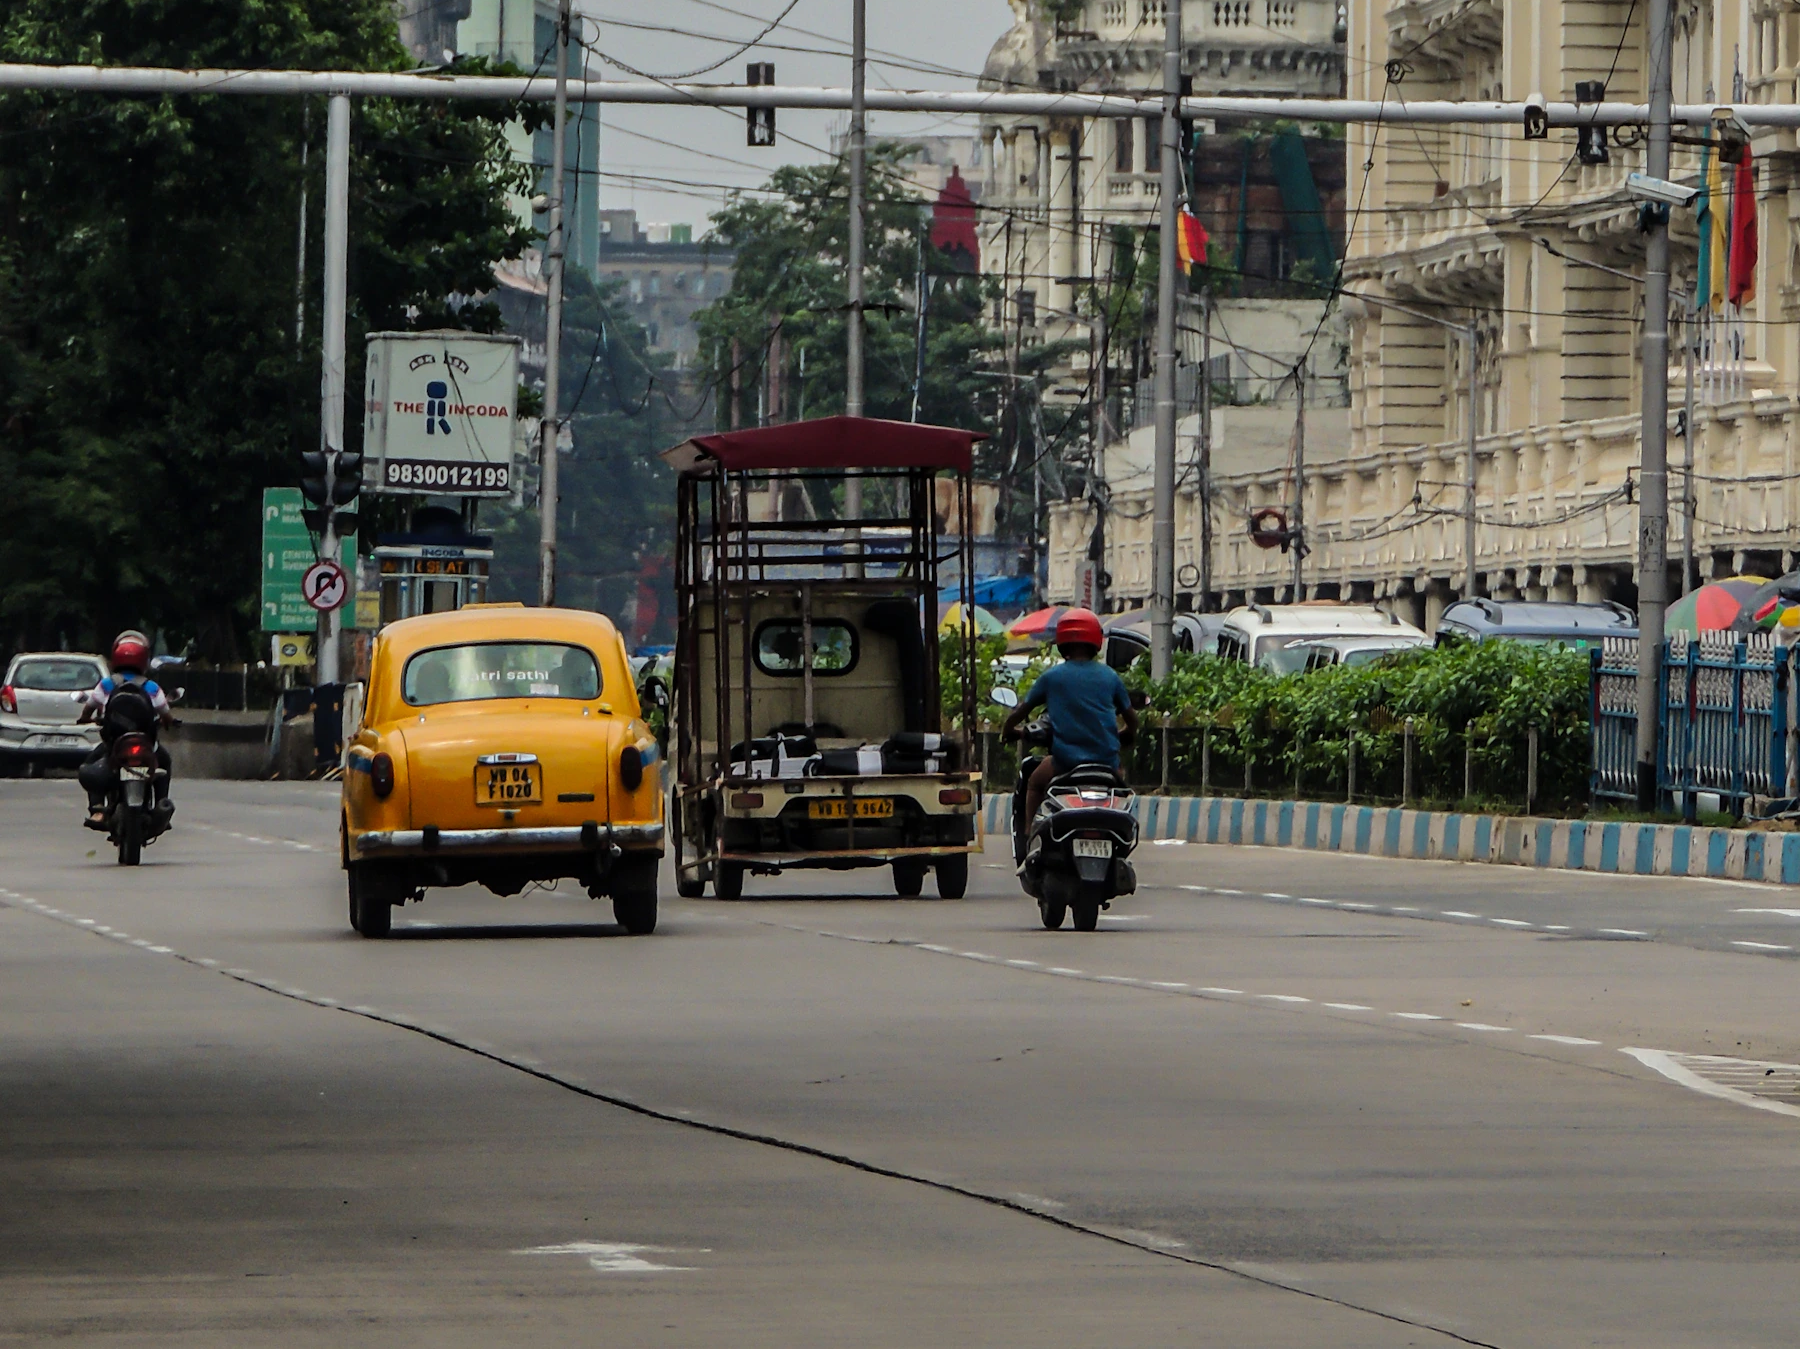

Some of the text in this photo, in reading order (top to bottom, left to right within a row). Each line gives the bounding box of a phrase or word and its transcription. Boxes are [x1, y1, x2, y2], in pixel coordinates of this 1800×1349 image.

[394, 401, 425, 413] THE
[388, 463, 508, 488] 9830012199
[506, 670, 549, 681] sathi
[512, 767, 529, 782] 04
